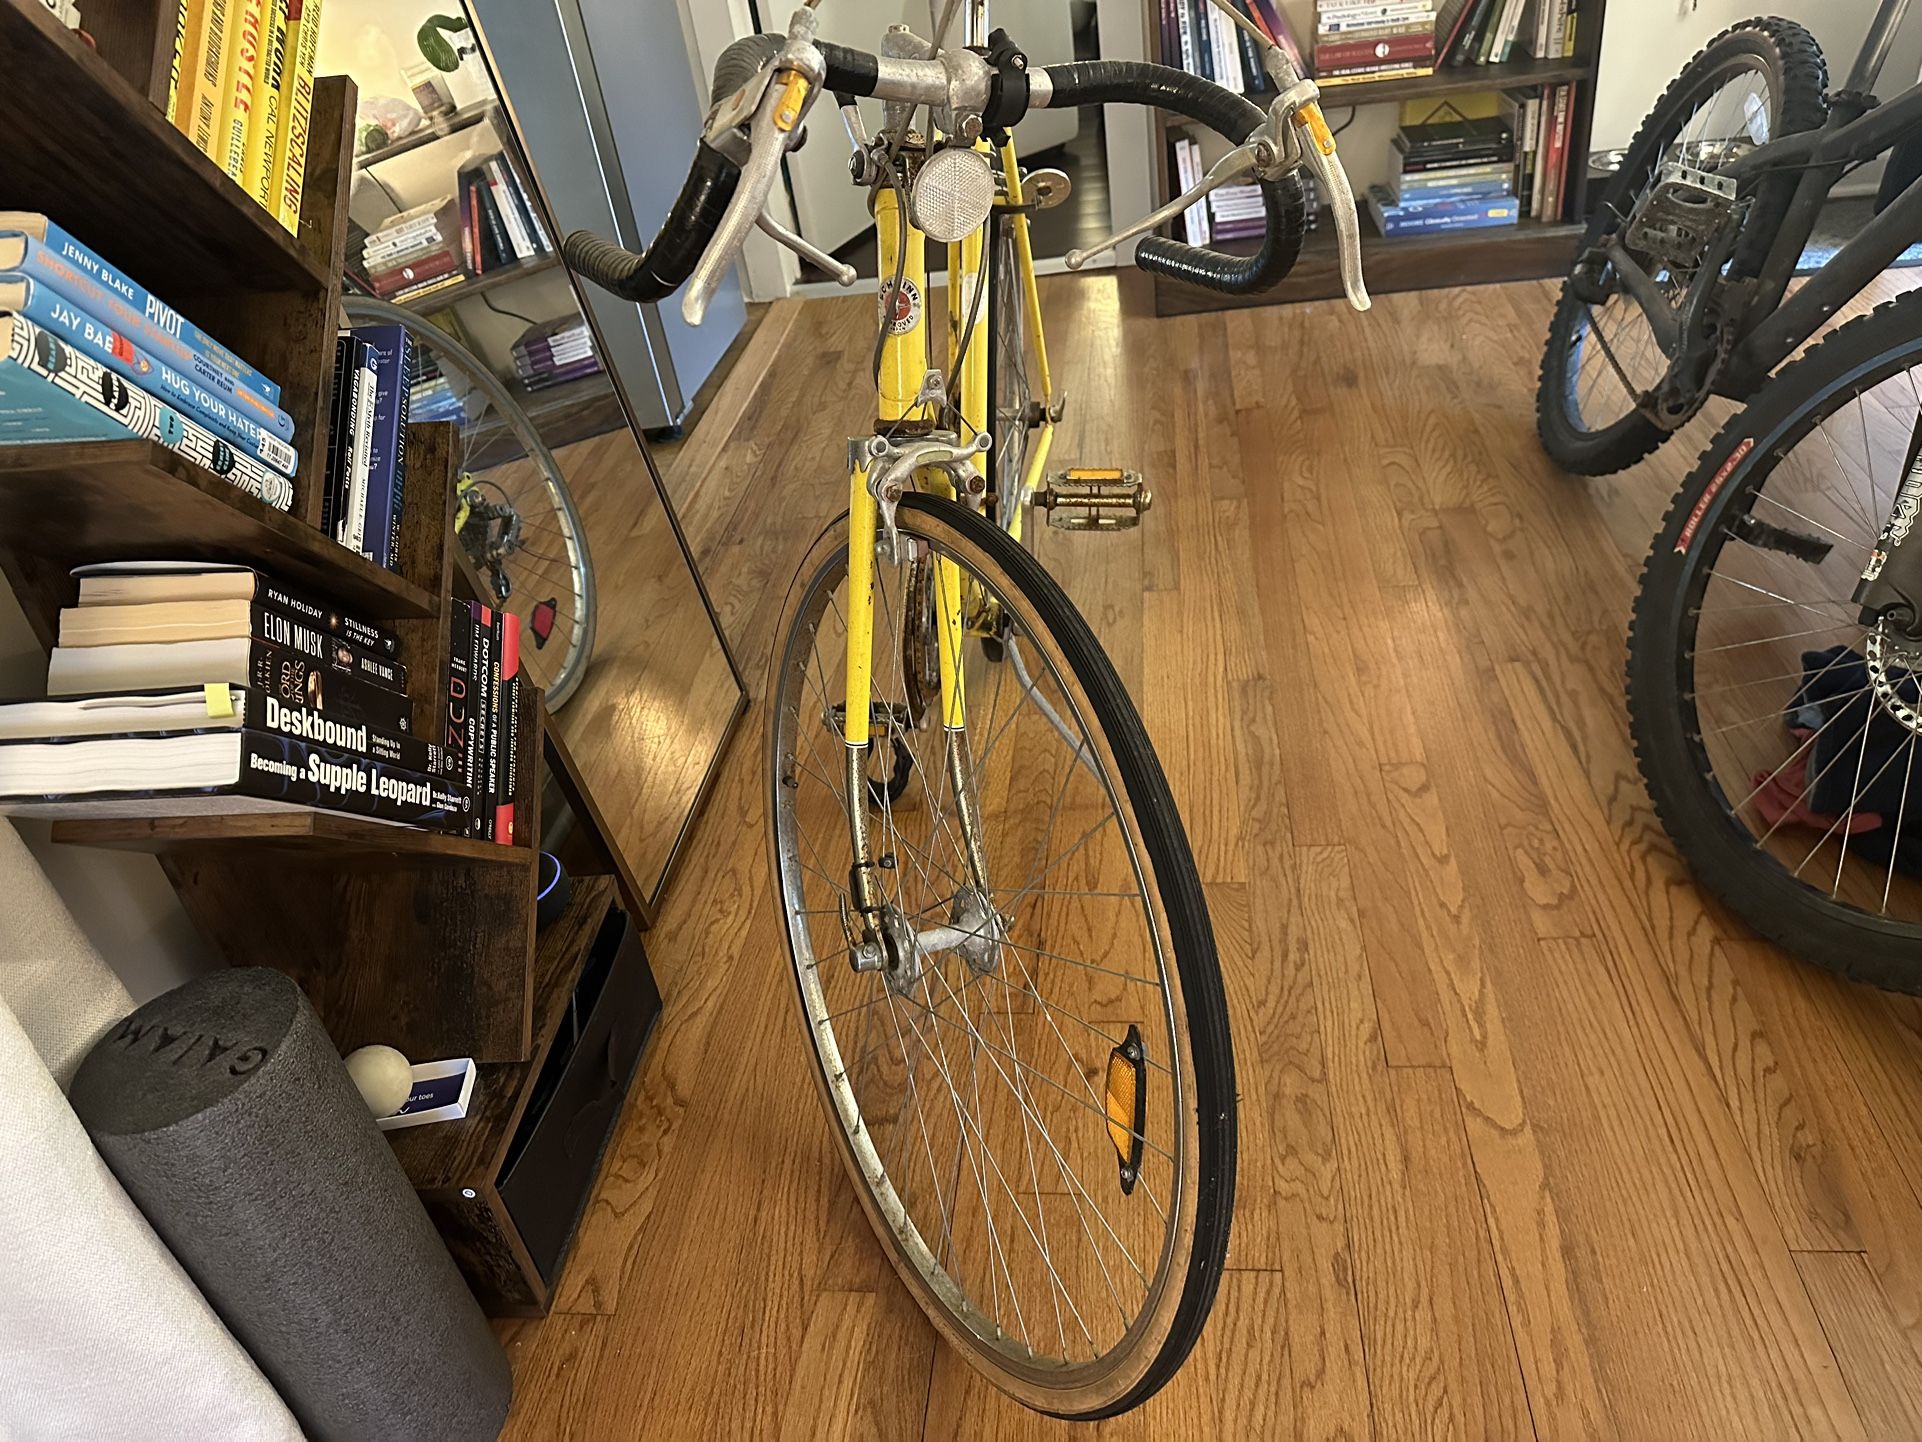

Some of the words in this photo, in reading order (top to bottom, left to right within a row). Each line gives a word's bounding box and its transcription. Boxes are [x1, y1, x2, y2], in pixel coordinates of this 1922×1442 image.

[310, 2, 320, 29] REID
[234, 9, 260, 113] HUSTLE
[306, 27, 318, 77] HOFFMAN
[199, 93, 214, 128] ANTONY
[267, 95, 278, 125] CAL
[228, 118, 244, 180] GUILLEBEA
[284, 73, 311, 214] BLITZSCALING
[259, 129, 275, 210] NEWPORT
[62, 242, 99, 274] JENNY
[101, 269, 134, 299] BLAKE
[145, 293, 184, 339] PIVOT
[880, 280, 918, 301] SCHINN
[50, 303, 81, 331] JAY
[84, 322, 114, 353] BAE
[193, 353, 223, 379] COURTNEY
[194, 364, 215, 385] CARTER
[216, 376, 233, 394] REUM
[402, 346, 412, 396] SLEEP
[109, 371, 121, 409] PLAYER
[161, 366, 190, 395] HUG
[192, 386, 226, 418] YOUR
[349, 369, 360, 436] VAGABONDING
[167, 415, 176, 435] TWO
[398, 397, 408, 465] SOLUTION
[344, 466, 352, 489] Potts
[267, 588, 289, 605] RYAN
[290, 598, 323, 619] HOLIDAY
[264, 612, 291, 646] ELON
[294, 623, 323, 659] MUSK
[344, 617, 379, 639] STILLNESS
[346, 630, 352, 638] IS
[352, 632, 363, 643] THE
[363, 636, 375, 647] KEY
[265, 651, 273, 694] OLKIEN
[280, 661, 291, 699] ORD
[361, 657, 379, 676] ASHLEE
[379, 664, 394, 681] VANCE
[480, 637, 490, 698] DOTCOM
[492, 661, 500, 714] CONFESSIONS
[266, 696, 367, 753] Deskbound
[372, 734, 390, 749] Standing
[490, 729, 498, 757] PUBLIC
[375, 746, 389, 759] Sitting
[389, 750, 401, 760] World
[250, 753, 297, 781] Becoming
[299, 767, 306, 780] a
[308, 753, 367, 795] Supple
[371, 768, 431, 807] Leopard
[488, 758, 496, 794] SPEAKER
[113, 1021, 268, 1076] GAIAM
[418, 1092, 434, 1101] toes
